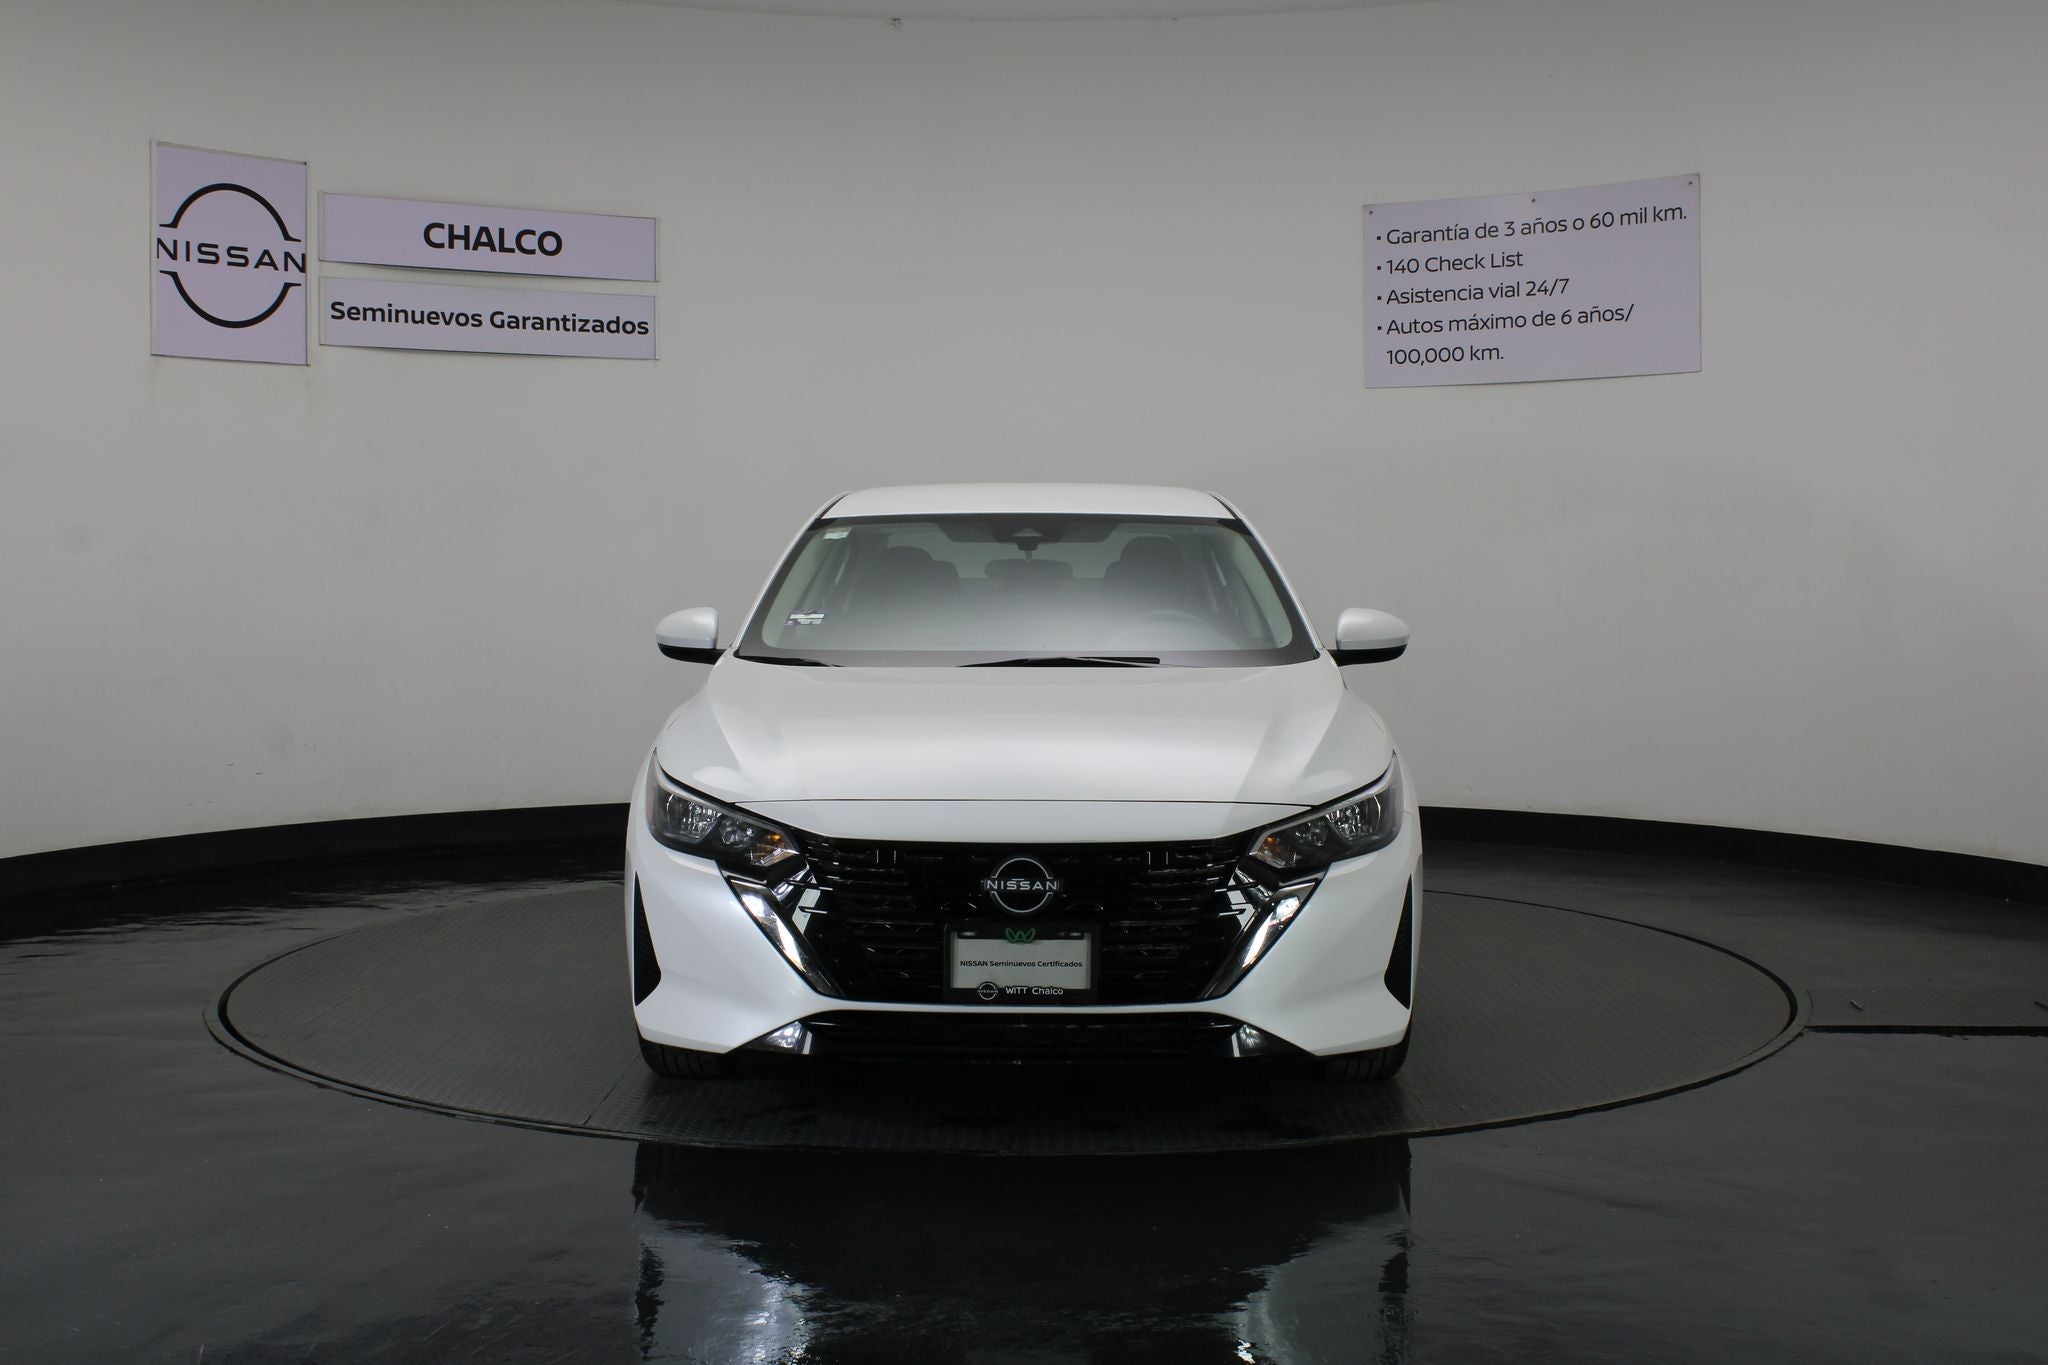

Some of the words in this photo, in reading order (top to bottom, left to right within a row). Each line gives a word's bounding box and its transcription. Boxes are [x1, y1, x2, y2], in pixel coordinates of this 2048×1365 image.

[1387, 224, 1469, 245] Garantía
[1475, 222, 1499, 238] de
[1504, 221, 1515, 236] 3
[1521, 216, 1567, 235] años
[1573, 218, 1584, 231] o
[1590, 212, 1614, 229] 60
[1620, 208, 1647, 226] mil
[1653, 205, 1687, 223] km.
[423, 222, 563, 257] CHALCO
[157, 237, 307, 274] NISSAN
[1386, 259, 1420, 274] 140
[1425, 254, 1485, 272] Check
[1491, 251, 1523, 268] List
[1386, 282, 1484, 305] Asistencia
[1488, 281, 1520, 299] vial
[1526, 278, 1570, 297] 24/7
[330, 301, 483, 328] Seminuevos
[489, 310, 649, 336] Garantizados
[1386, 318, 1443, 335] Autos
[1449, 313, 1527, 332] máximo
[1532, 311, 1556, 327] de
[1561, 309, 1572, 325] 6
[1578, 304, 1634, 324] años/
[1386, 347, 1464, 366] 100,000
[1470, 345, 1504, 361] km.
[987, 880, 1057, 890] NISSAN
[1038, 960, 1082, 968] Certificados
[1005, 987, 1028, 995] WITT
[1032, 987, 1063, 995] Chalco
